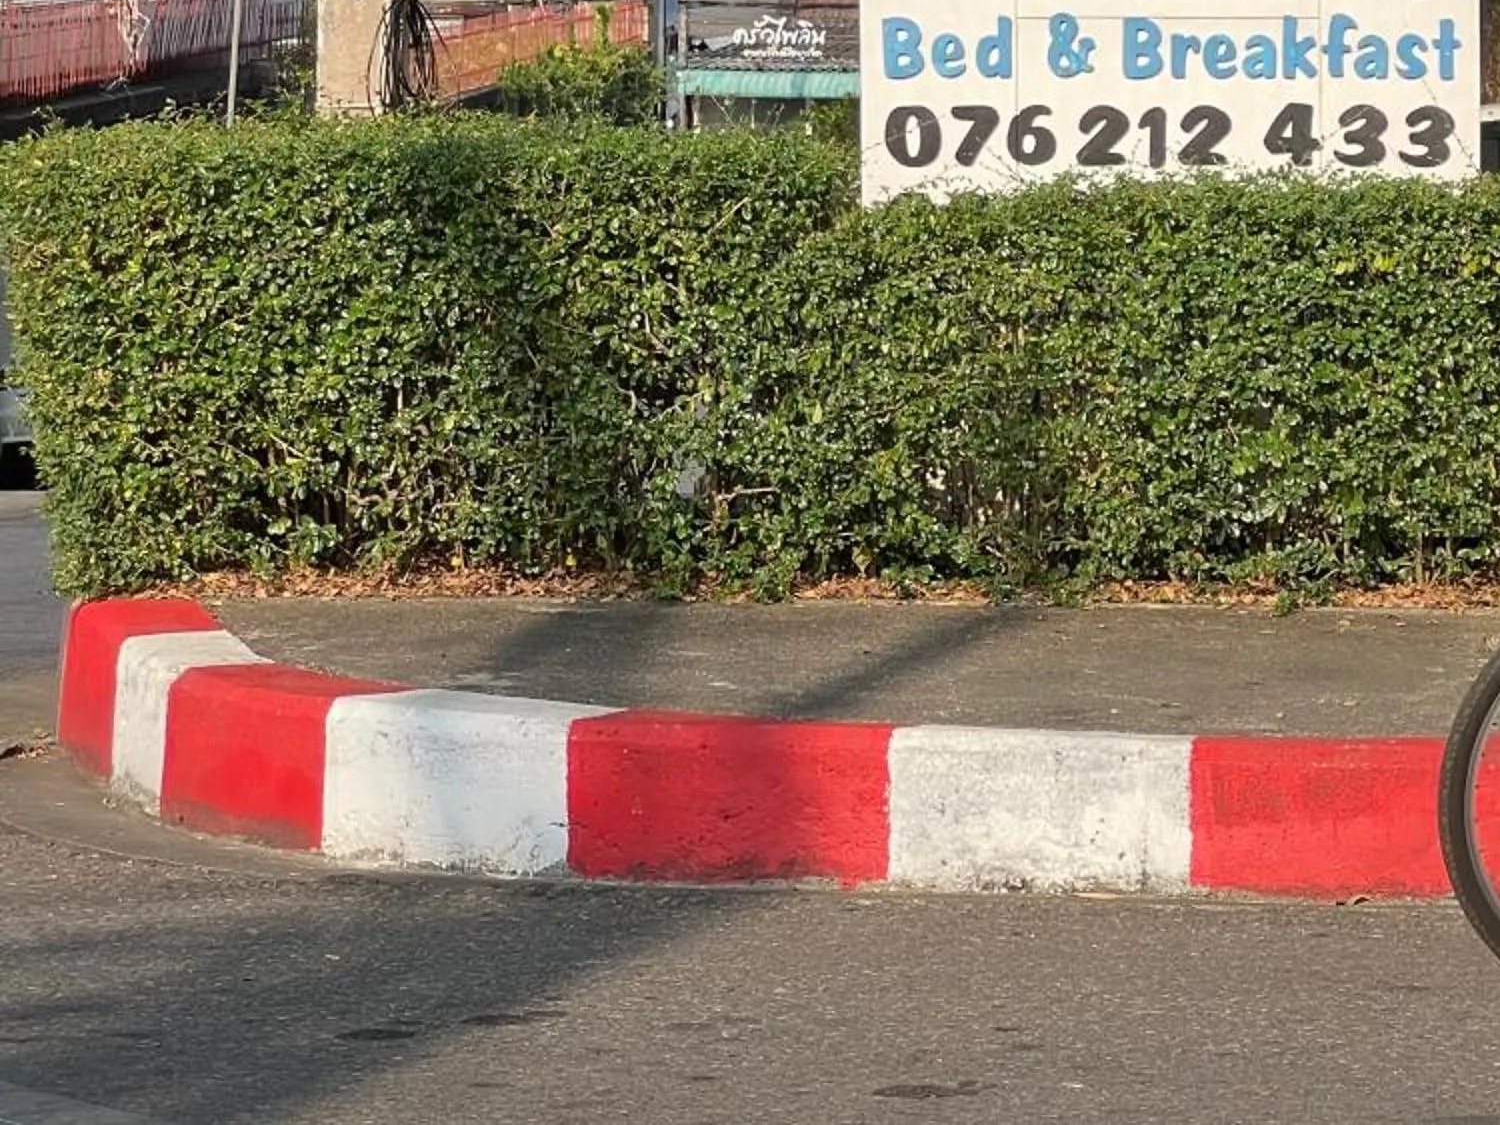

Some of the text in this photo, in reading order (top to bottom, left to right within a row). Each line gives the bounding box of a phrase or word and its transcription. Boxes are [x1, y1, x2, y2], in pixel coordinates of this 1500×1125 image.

[882, 12, 1461, 80] Bed & Breakfast
[884, 102, 1455, 169] 076 212 433
